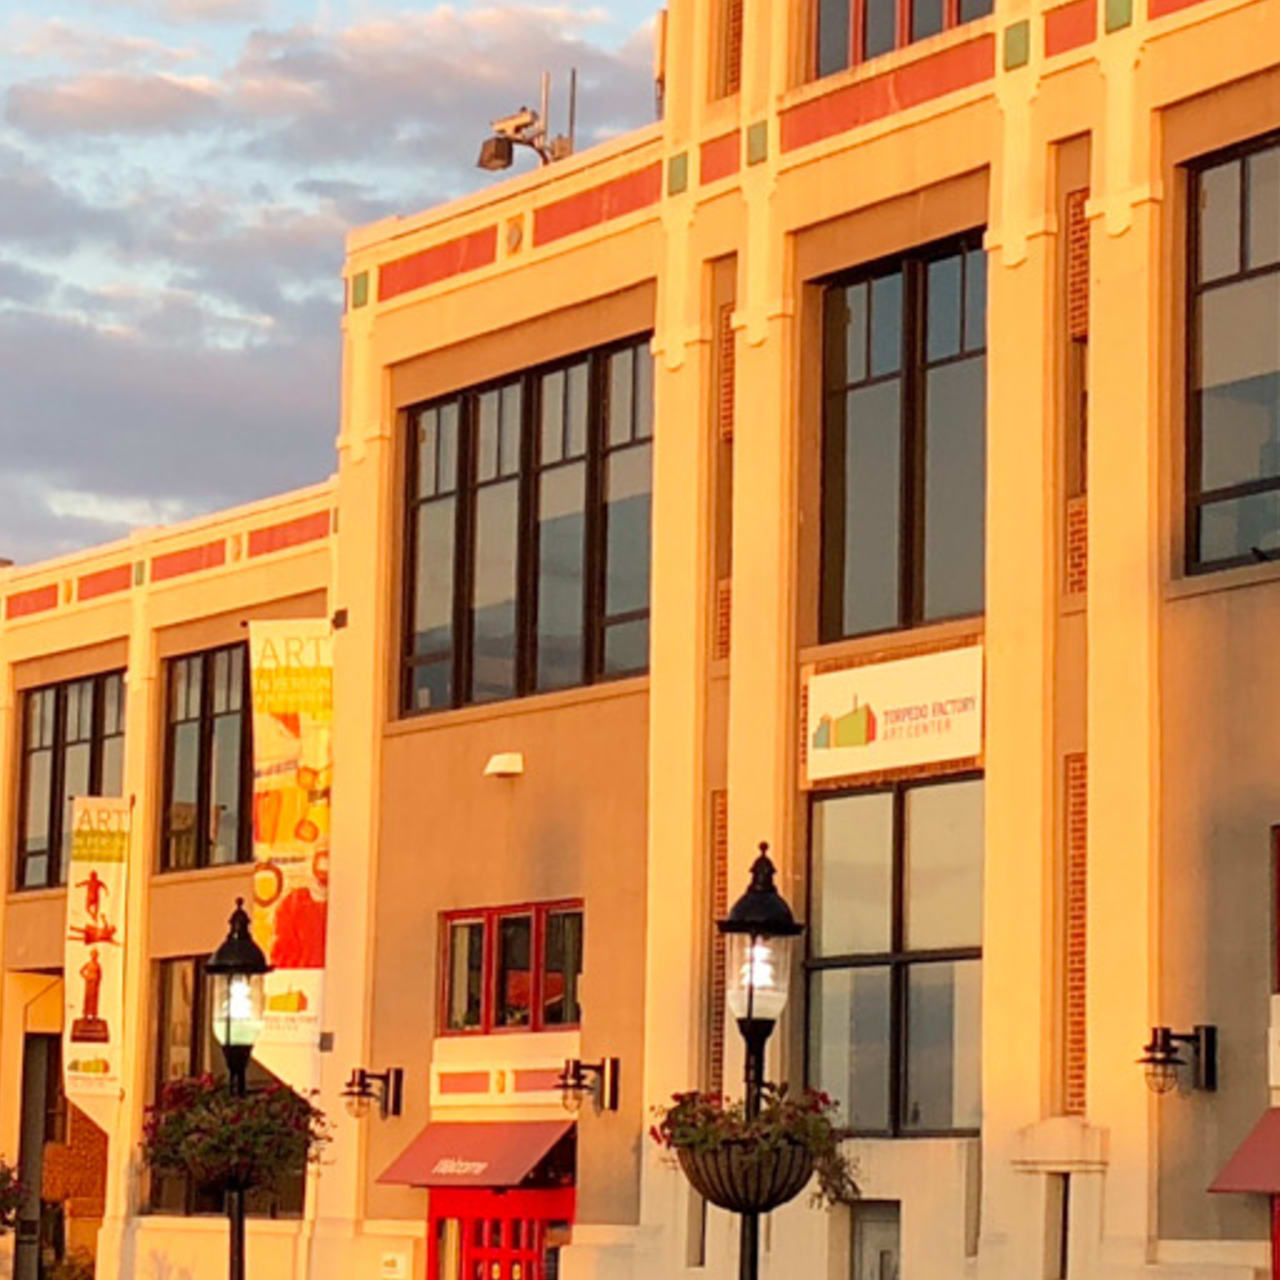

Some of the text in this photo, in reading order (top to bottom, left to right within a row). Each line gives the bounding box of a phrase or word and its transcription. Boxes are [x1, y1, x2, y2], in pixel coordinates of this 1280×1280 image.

[260, 636, 329, 667] ART
[883, 697, 976, 725] TORPEDO FACTORY
[883, 719, 951, 740] ART CENTER
[78, 809, 128, 832] ART
